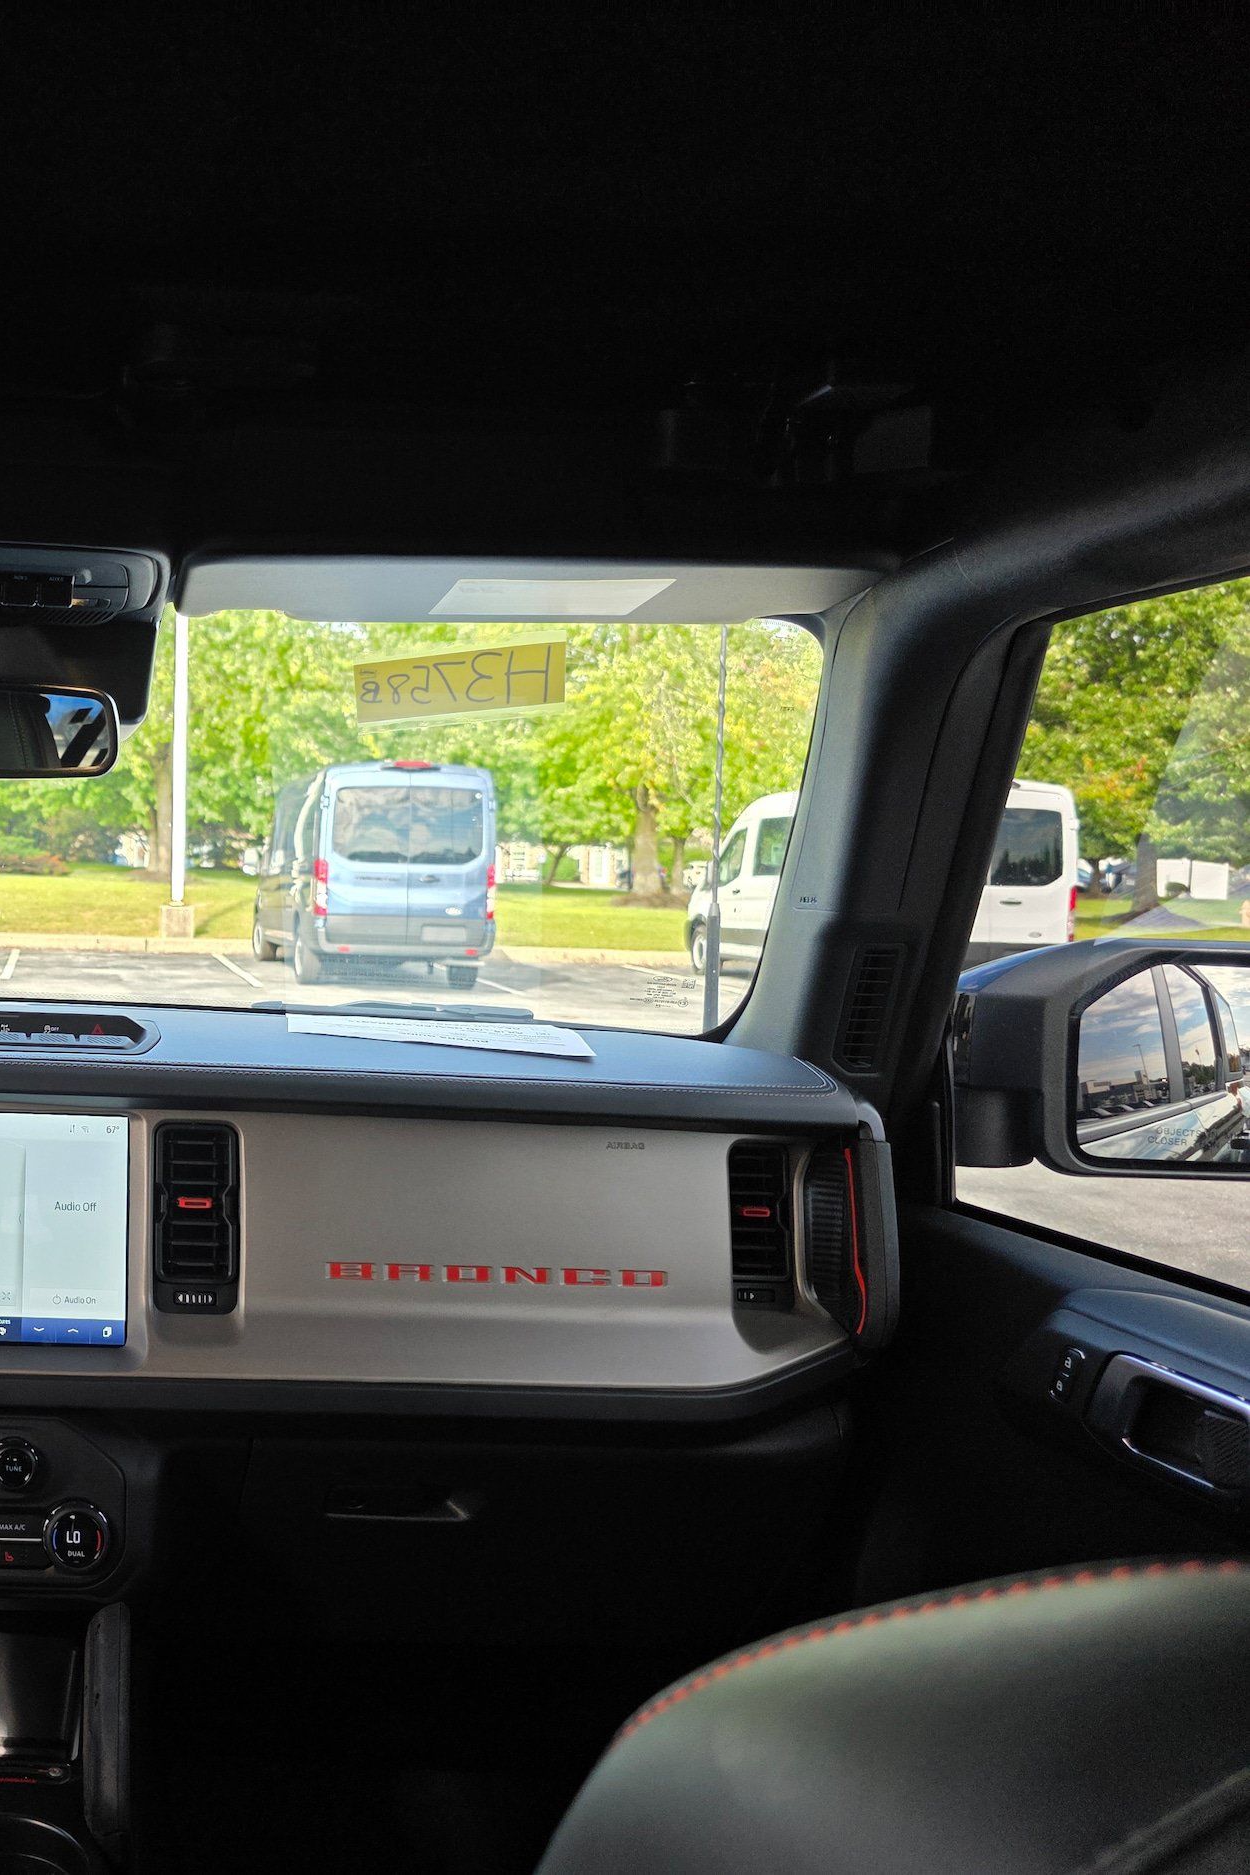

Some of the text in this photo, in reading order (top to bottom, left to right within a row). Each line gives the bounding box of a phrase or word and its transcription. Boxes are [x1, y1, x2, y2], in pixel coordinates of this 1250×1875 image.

[1156, 1127, 1201, 1137] OBJECTS
[606, 1141, 645, 1150] AIRBAG
[1148, 1136, 1187, 1146] CLOSER
[54, 1201, 97, 1212] Audio Off
[326, 1262, 668, 1288] BRONCO
[66, 1530, 81, 1544] LO
